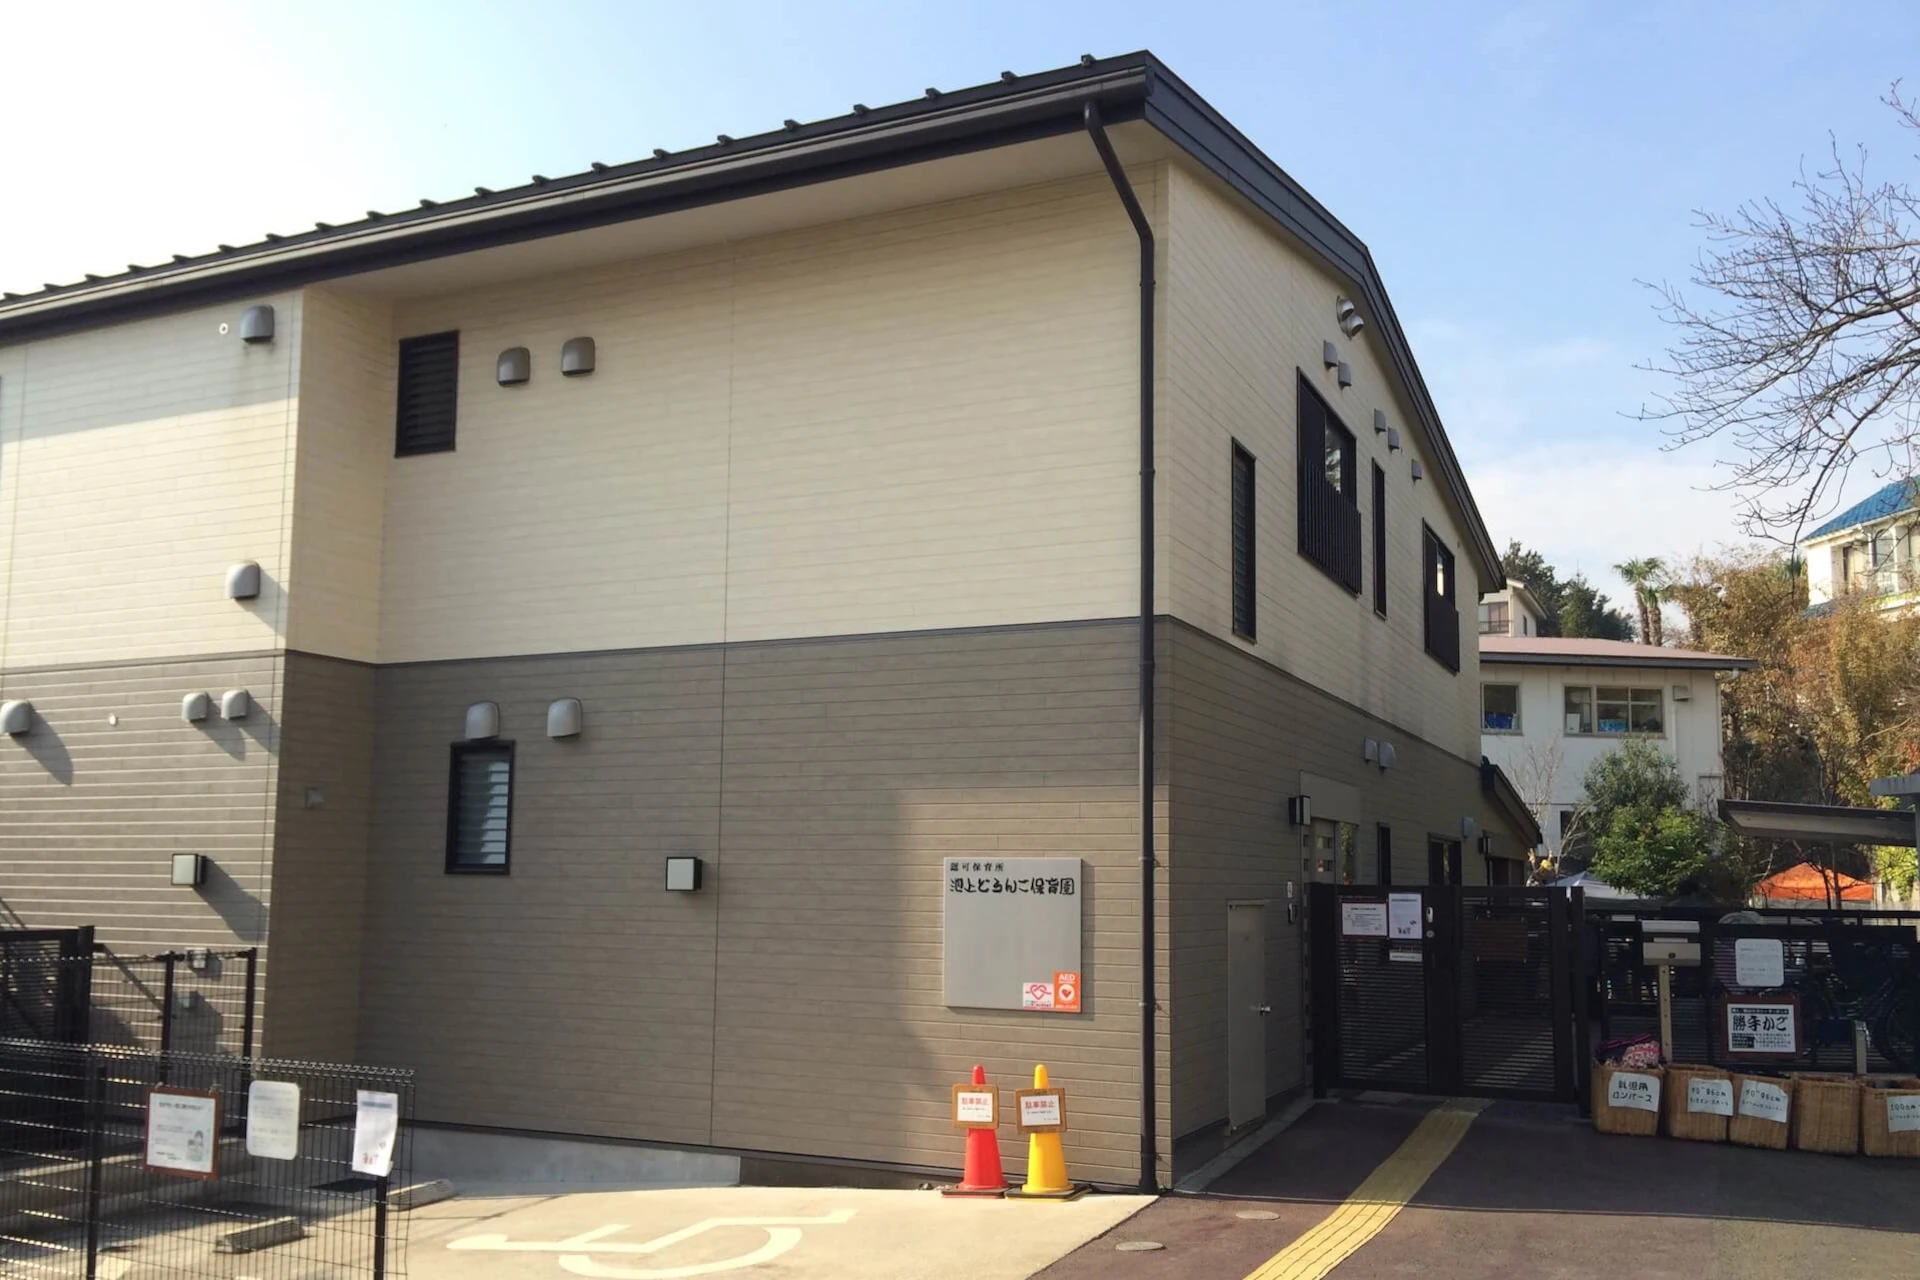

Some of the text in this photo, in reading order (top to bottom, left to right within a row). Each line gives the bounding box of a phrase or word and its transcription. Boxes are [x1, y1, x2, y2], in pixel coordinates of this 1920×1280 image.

[950, 877, 1075, 895] 池上どろんこ保育園
[1733, 1015, 1788, 1031] 勝手かご
[1612, 1090, 1652, 1103] ロンパース
[1024, 1099, 1056, 1110] 駐車禁止
